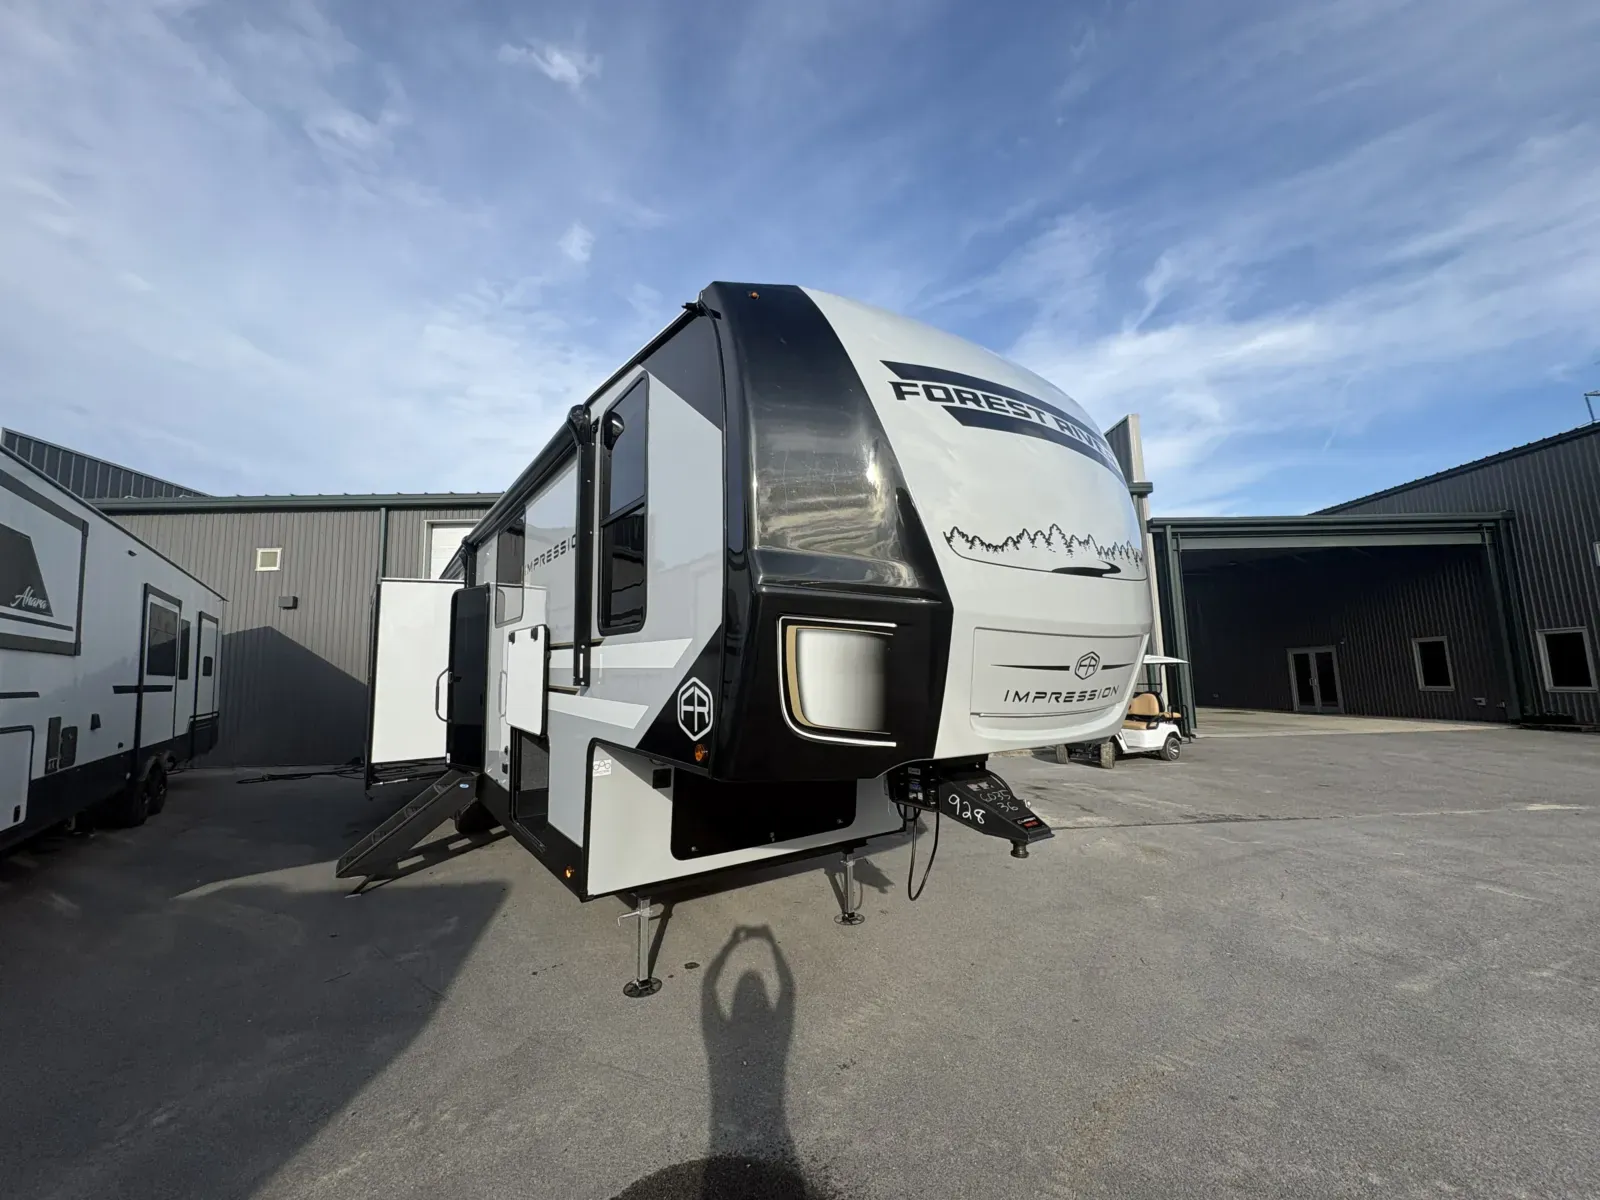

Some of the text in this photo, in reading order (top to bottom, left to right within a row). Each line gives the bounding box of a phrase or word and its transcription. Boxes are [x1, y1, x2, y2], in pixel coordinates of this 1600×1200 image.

[888, 381, 1117, 468] FOREST RIV
[10, 585, 47, 609] Ahara
[1004, 685, 1119, 703] IMPRESSION
[948, 794, 986, 825] 928
[996, 801, 1019, 813] 36
